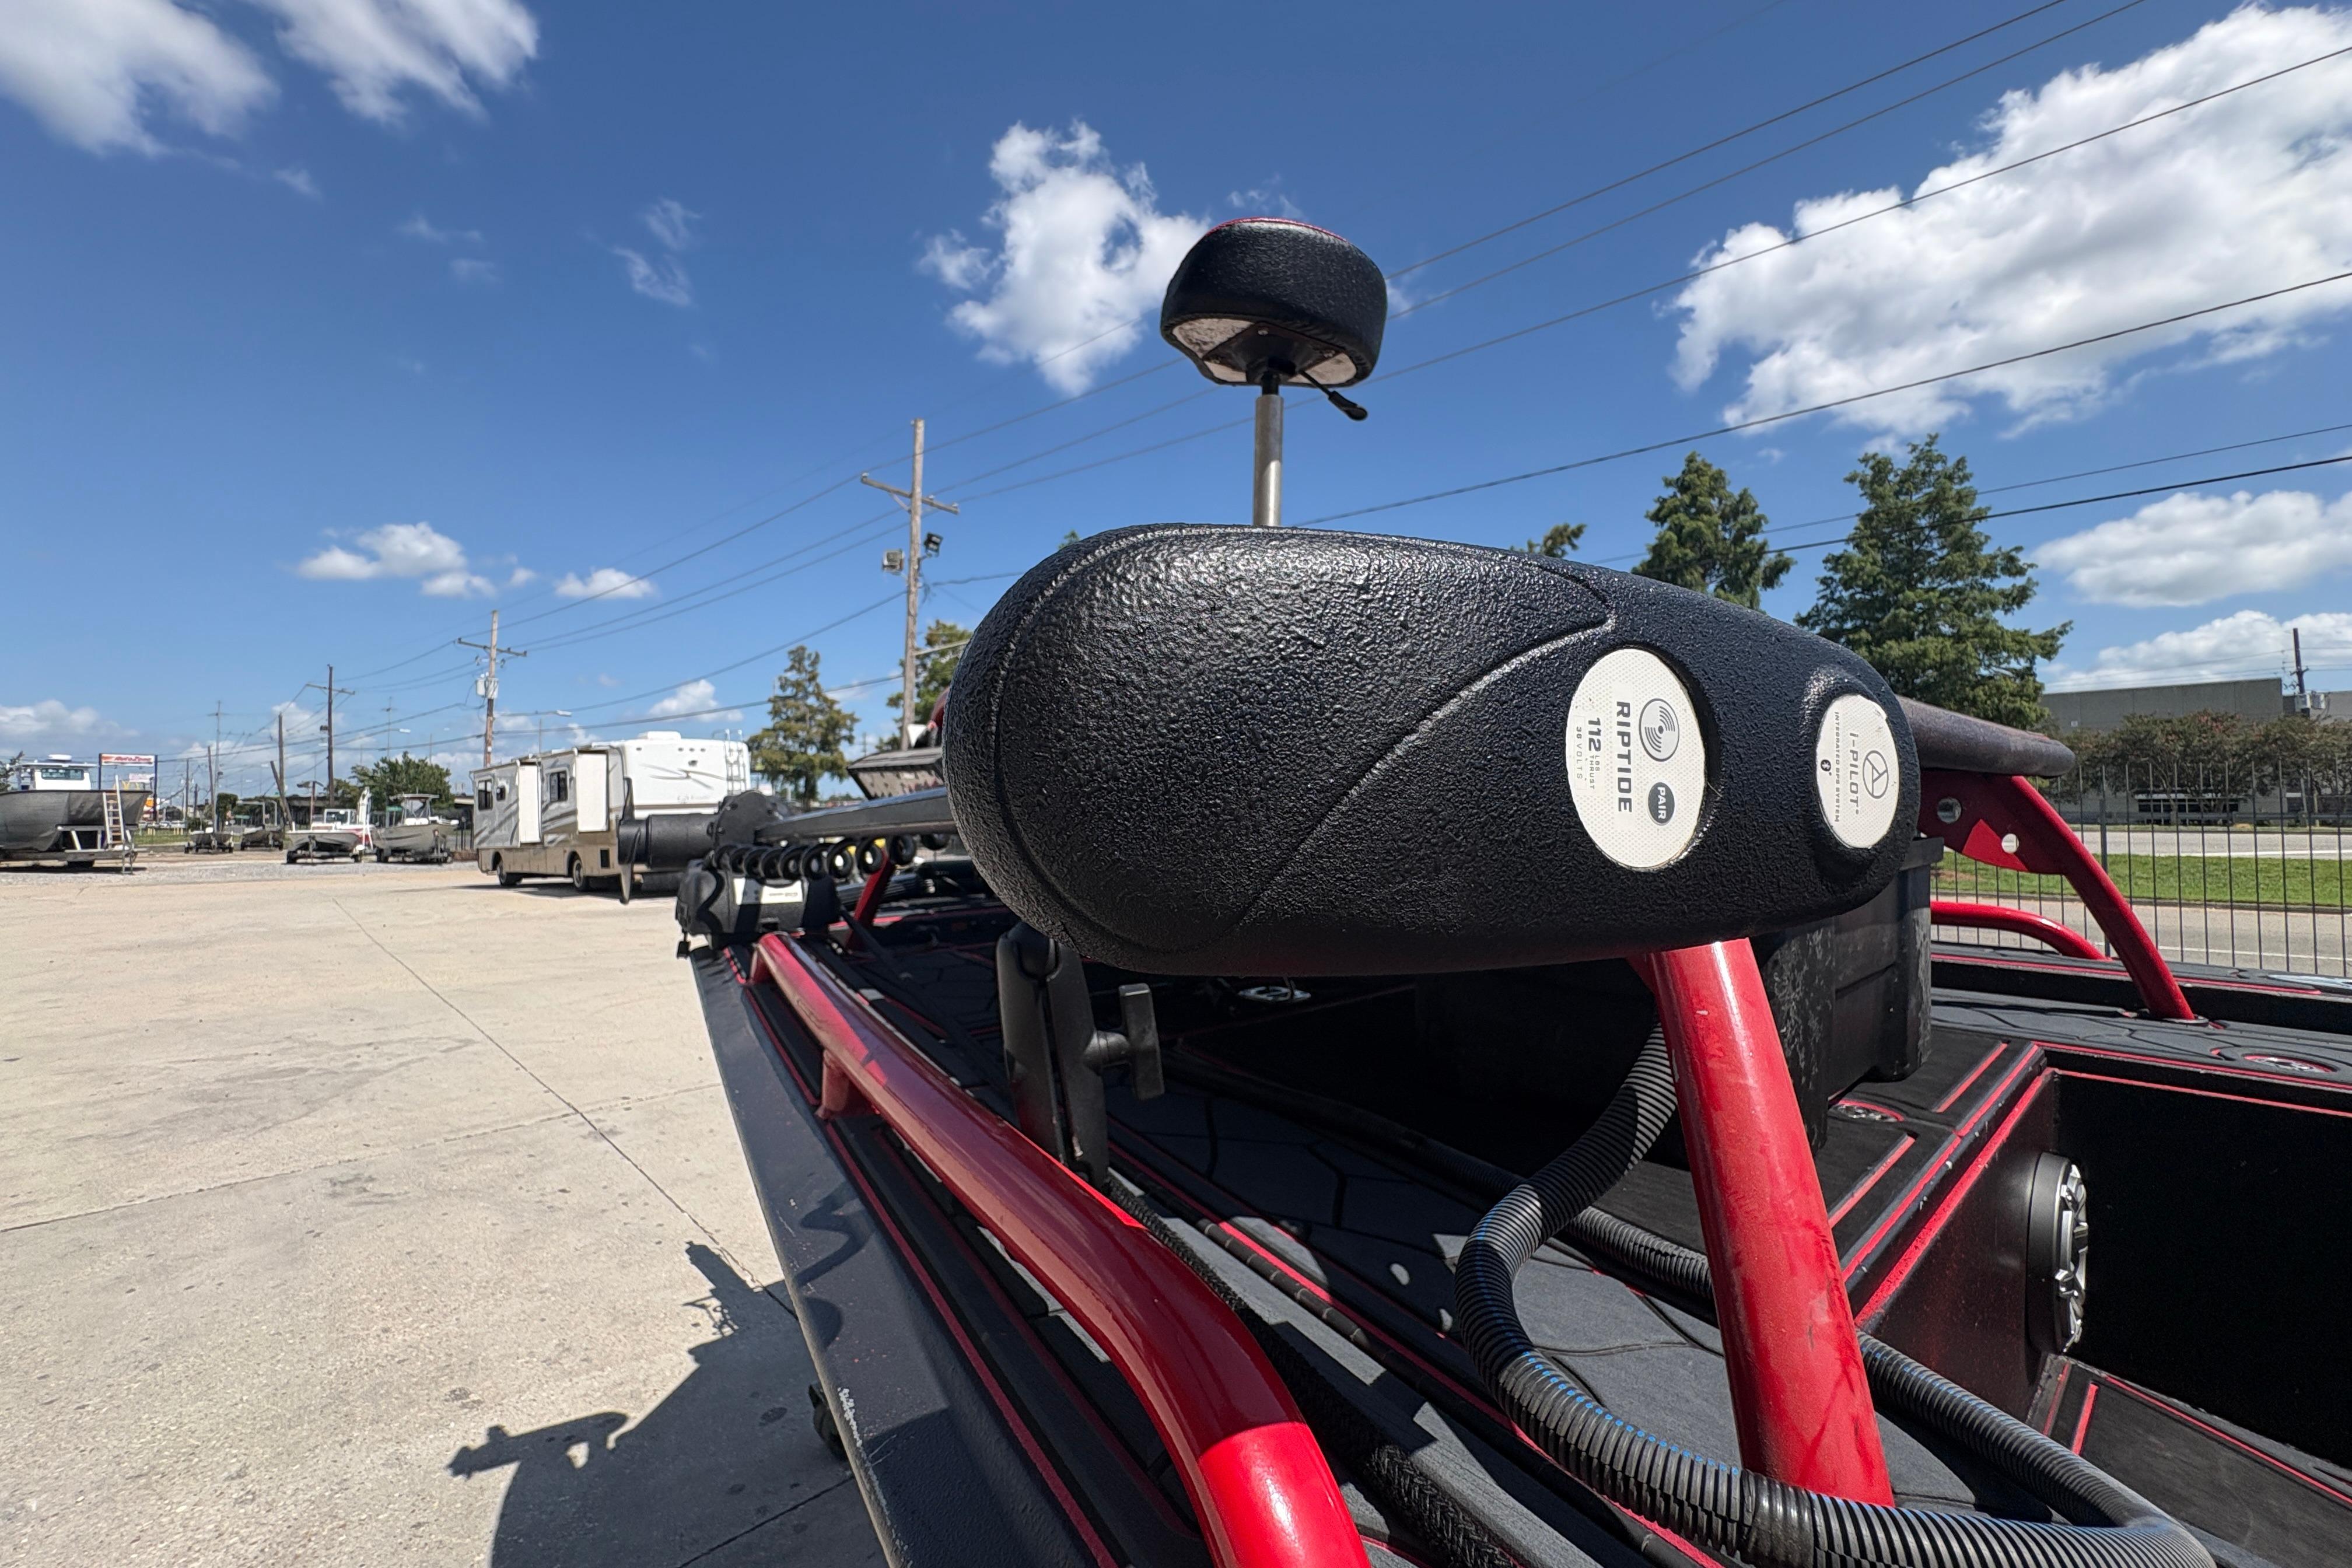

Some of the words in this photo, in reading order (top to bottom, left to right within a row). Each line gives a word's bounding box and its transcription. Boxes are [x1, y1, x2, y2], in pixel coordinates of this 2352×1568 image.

[1588, 718, 1602, 752] 112
[1616, 701, 1632, 813] RIPTIDE
[1657, 786, 1667, 820] PAIR
